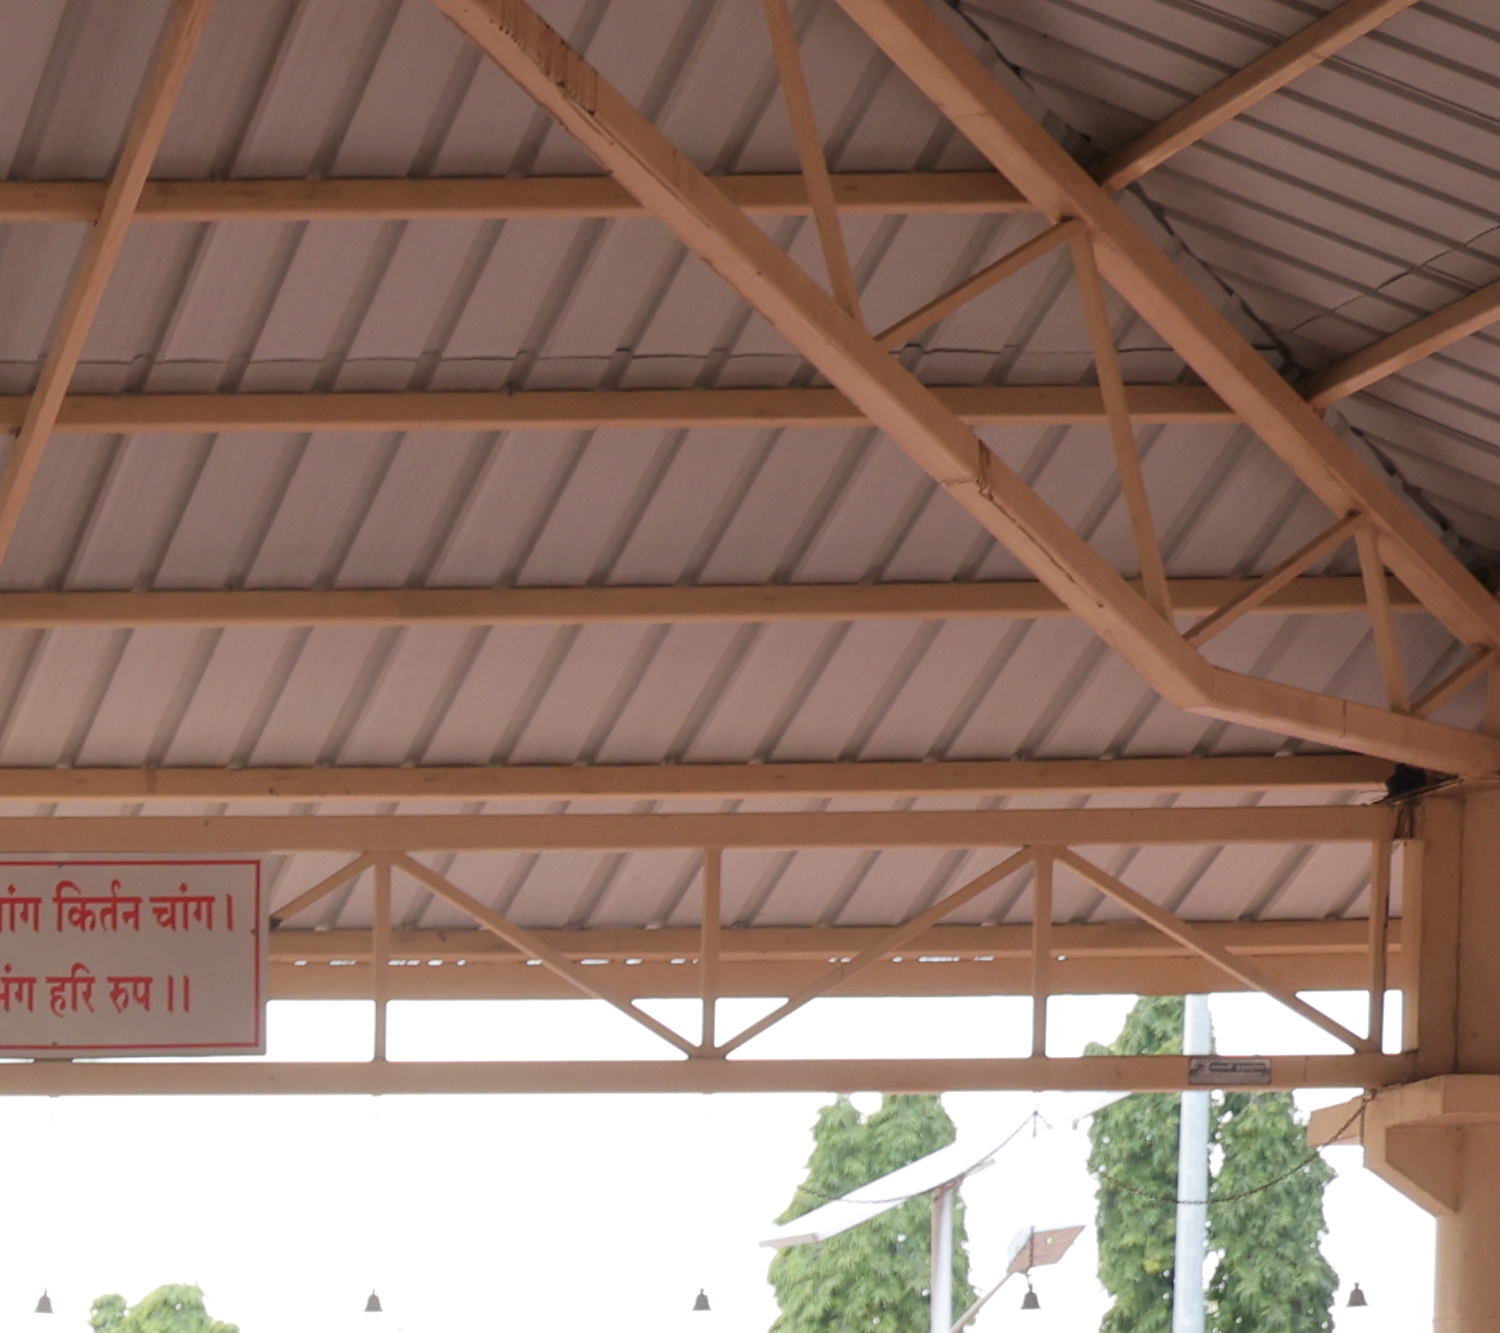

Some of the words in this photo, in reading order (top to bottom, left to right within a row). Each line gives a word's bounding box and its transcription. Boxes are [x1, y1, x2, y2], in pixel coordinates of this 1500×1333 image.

[52, 879, 143, 931] किर्तन
[150, 883, 217, 930] चांग
[46, 962, 97, 1018] हरि
[106, 975, 155, 1014] रुप
